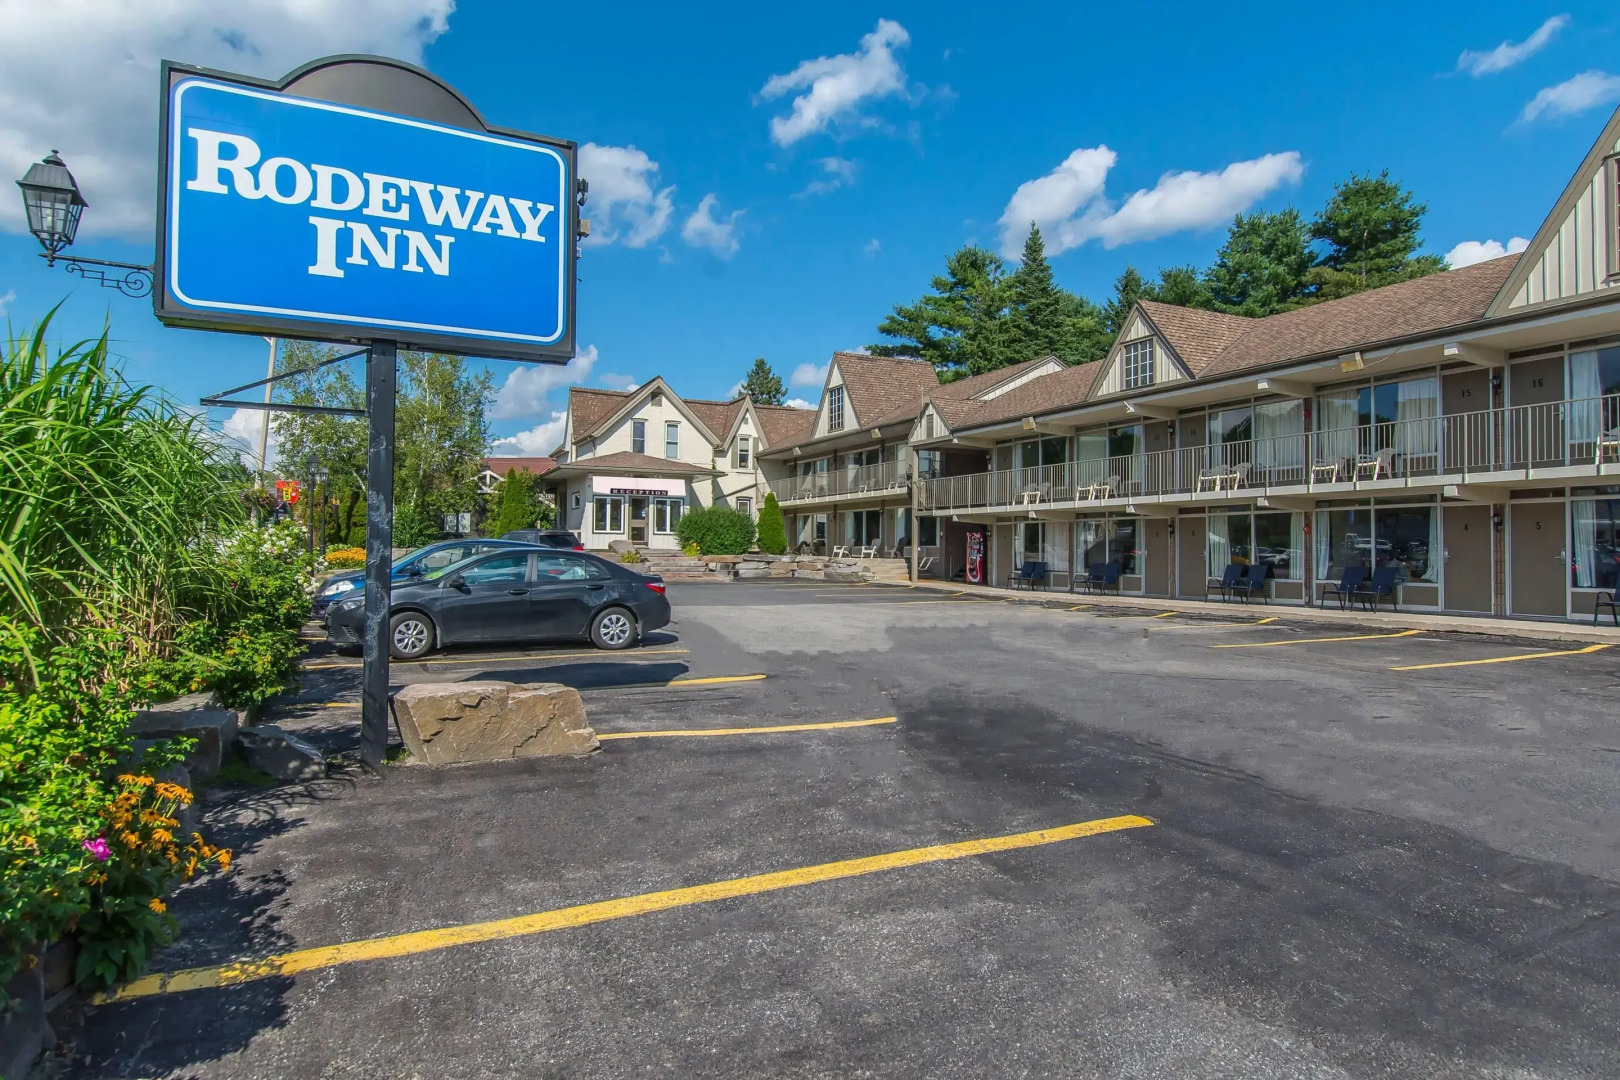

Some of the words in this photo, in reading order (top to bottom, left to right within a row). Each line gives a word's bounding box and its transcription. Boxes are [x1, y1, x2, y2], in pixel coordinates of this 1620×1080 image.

[186, 127, 555, 243] RODEWAY
[308, 215, 455, 278] INN
[1532, 378, 1544, 388] 16
[1461, 389, 1472, 398] 15
[1463, 523, 1469, 531] 4
[1535, 521, 1542, 530] 5
